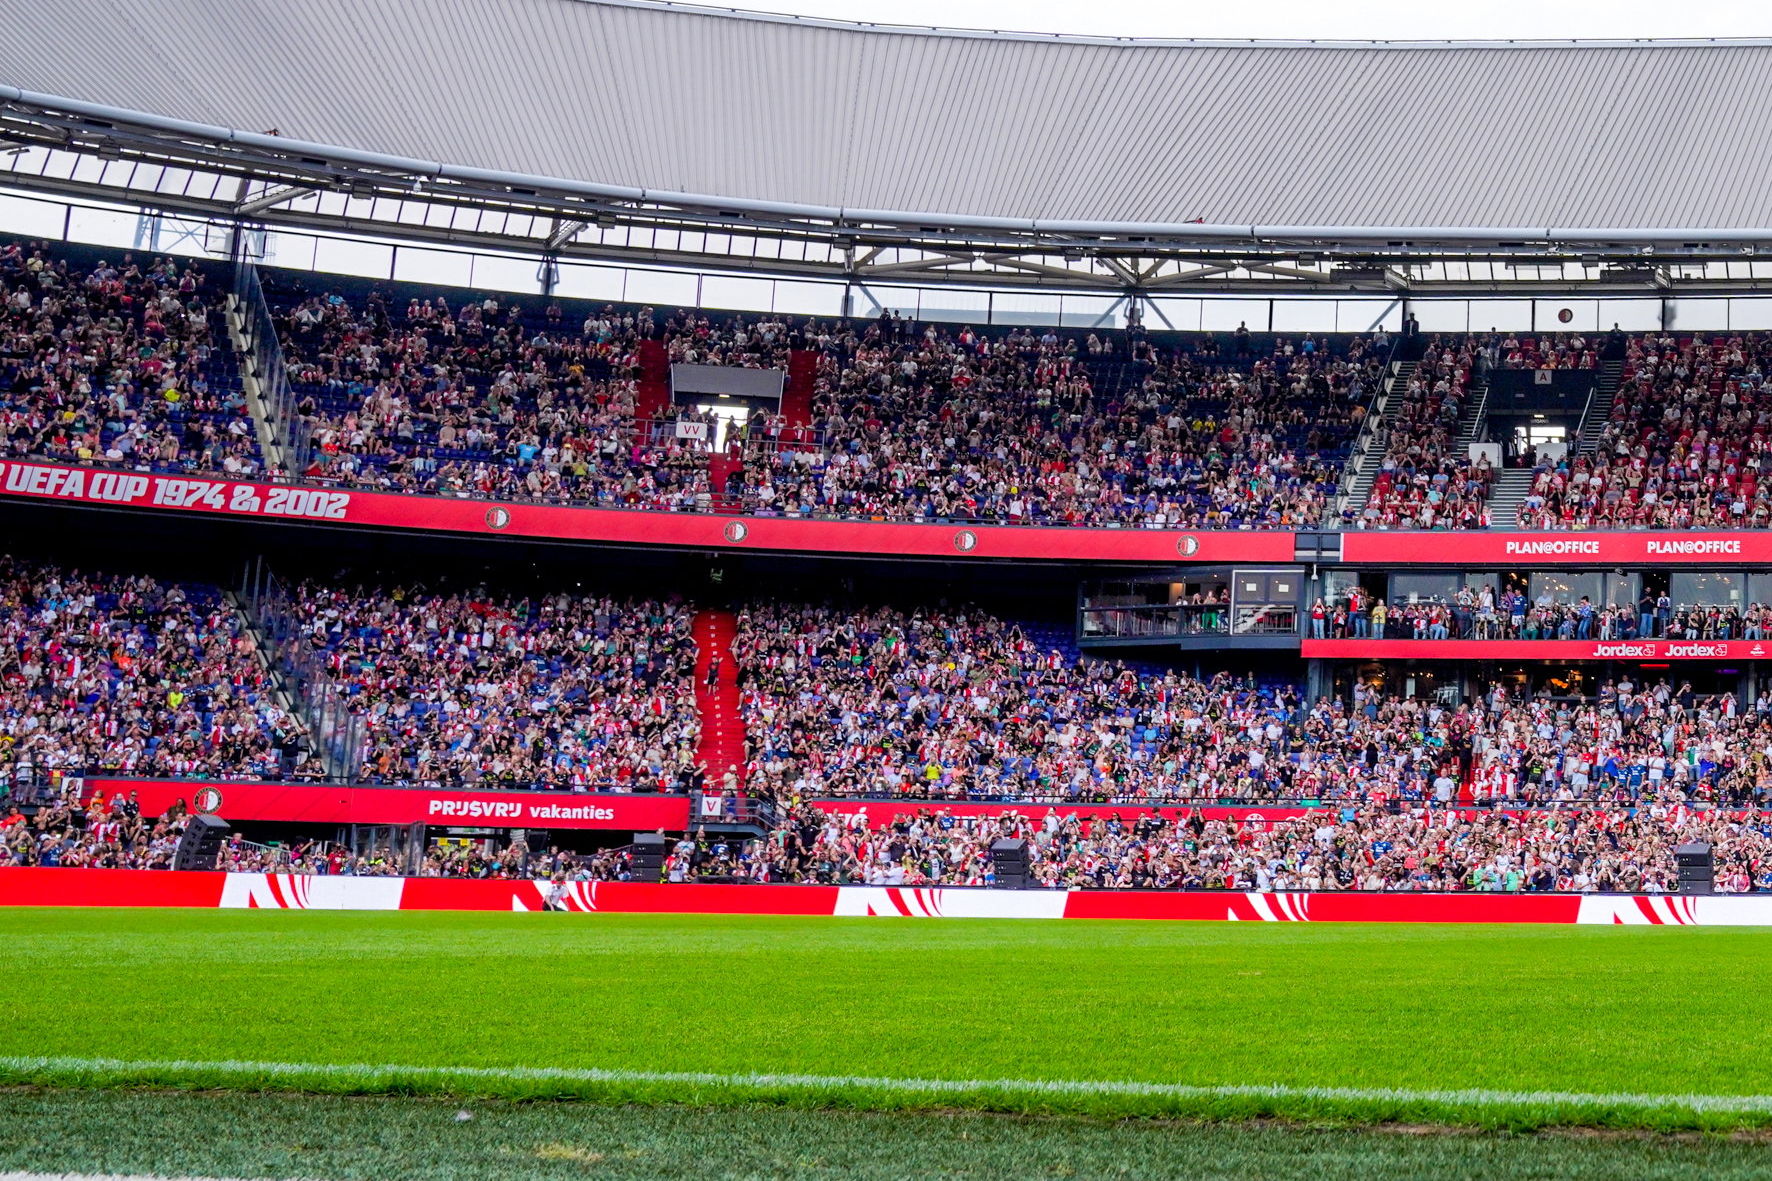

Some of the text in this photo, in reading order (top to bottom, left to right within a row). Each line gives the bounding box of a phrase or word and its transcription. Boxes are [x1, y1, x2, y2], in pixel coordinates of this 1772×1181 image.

[1540, 372, 1547, 381] A
[684, 425, 700, 435] VV
[6, 464, 84, 497] UEFA
[88, 472, 149, 502] CUP
[153, 477, 226, 510] 1974
[230, 484, 260, 512] &
[264, 487, 350, 519] 2002
[1506, 541, 1599, 554] PLAN@OFFICE
[1647, 540, 1741, 554] PLAN@OFFICE
[1593, 643, 1643, 657] Jordex
[1665, 643, 1715, 657] Jordex
[529, 804, 614, 820] vakanties
[706, 800, 717, 812] V
